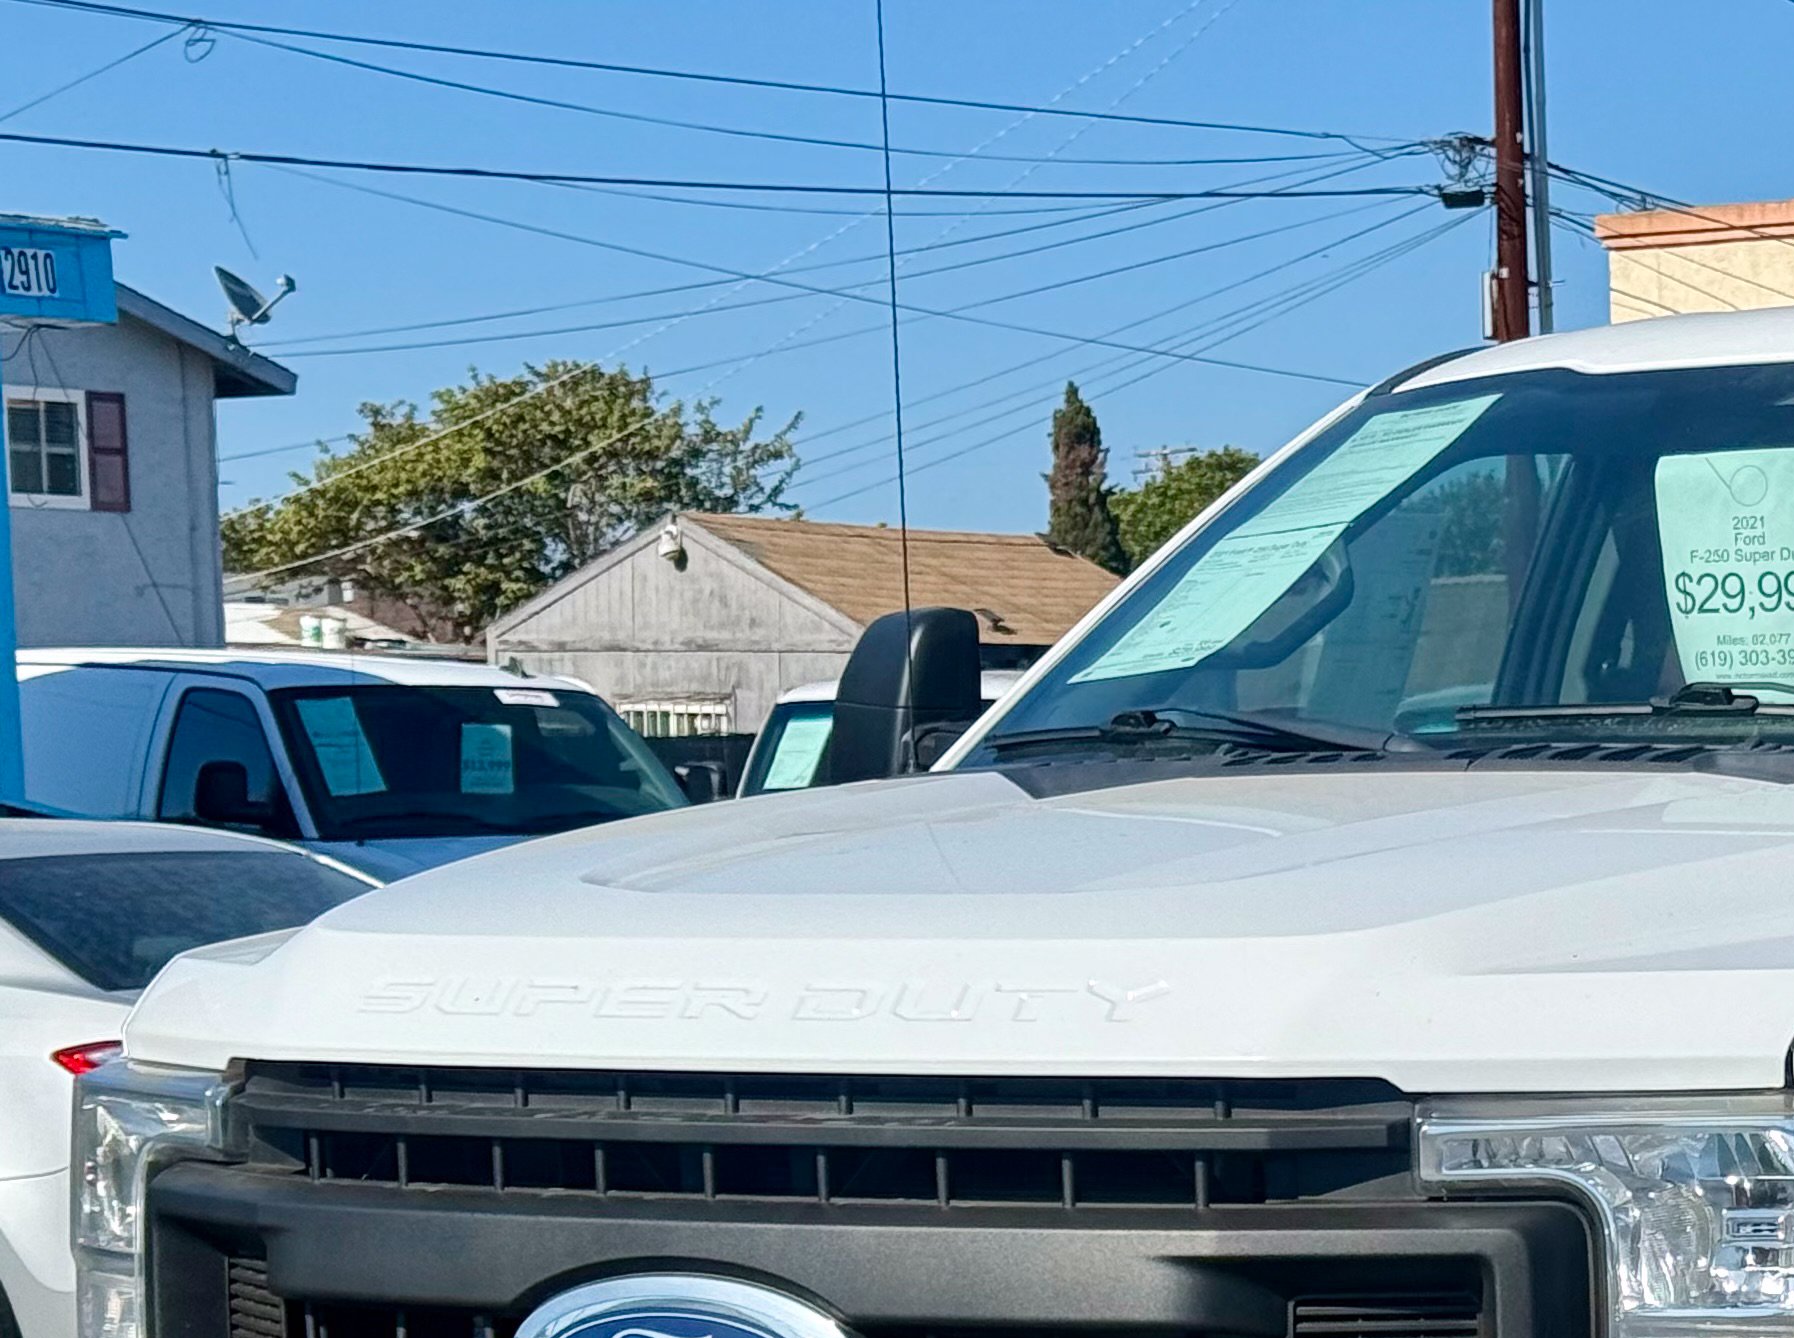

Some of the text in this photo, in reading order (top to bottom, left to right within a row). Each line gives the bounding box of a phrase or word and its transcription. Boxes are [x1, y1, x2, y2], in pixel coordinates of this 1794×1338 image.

[4, 247, 57, 294] 2910
[1732, 515, 1765, 530] 2021
[1734, 532, 1766, 546] Ford
[1690, 549, 1730, 563] F-250
[1734, 548, 1776, 565] Super
[1695, 650, 1734, 670] (619)
[357, 977, 1171, 1023] SUPER DUTY
